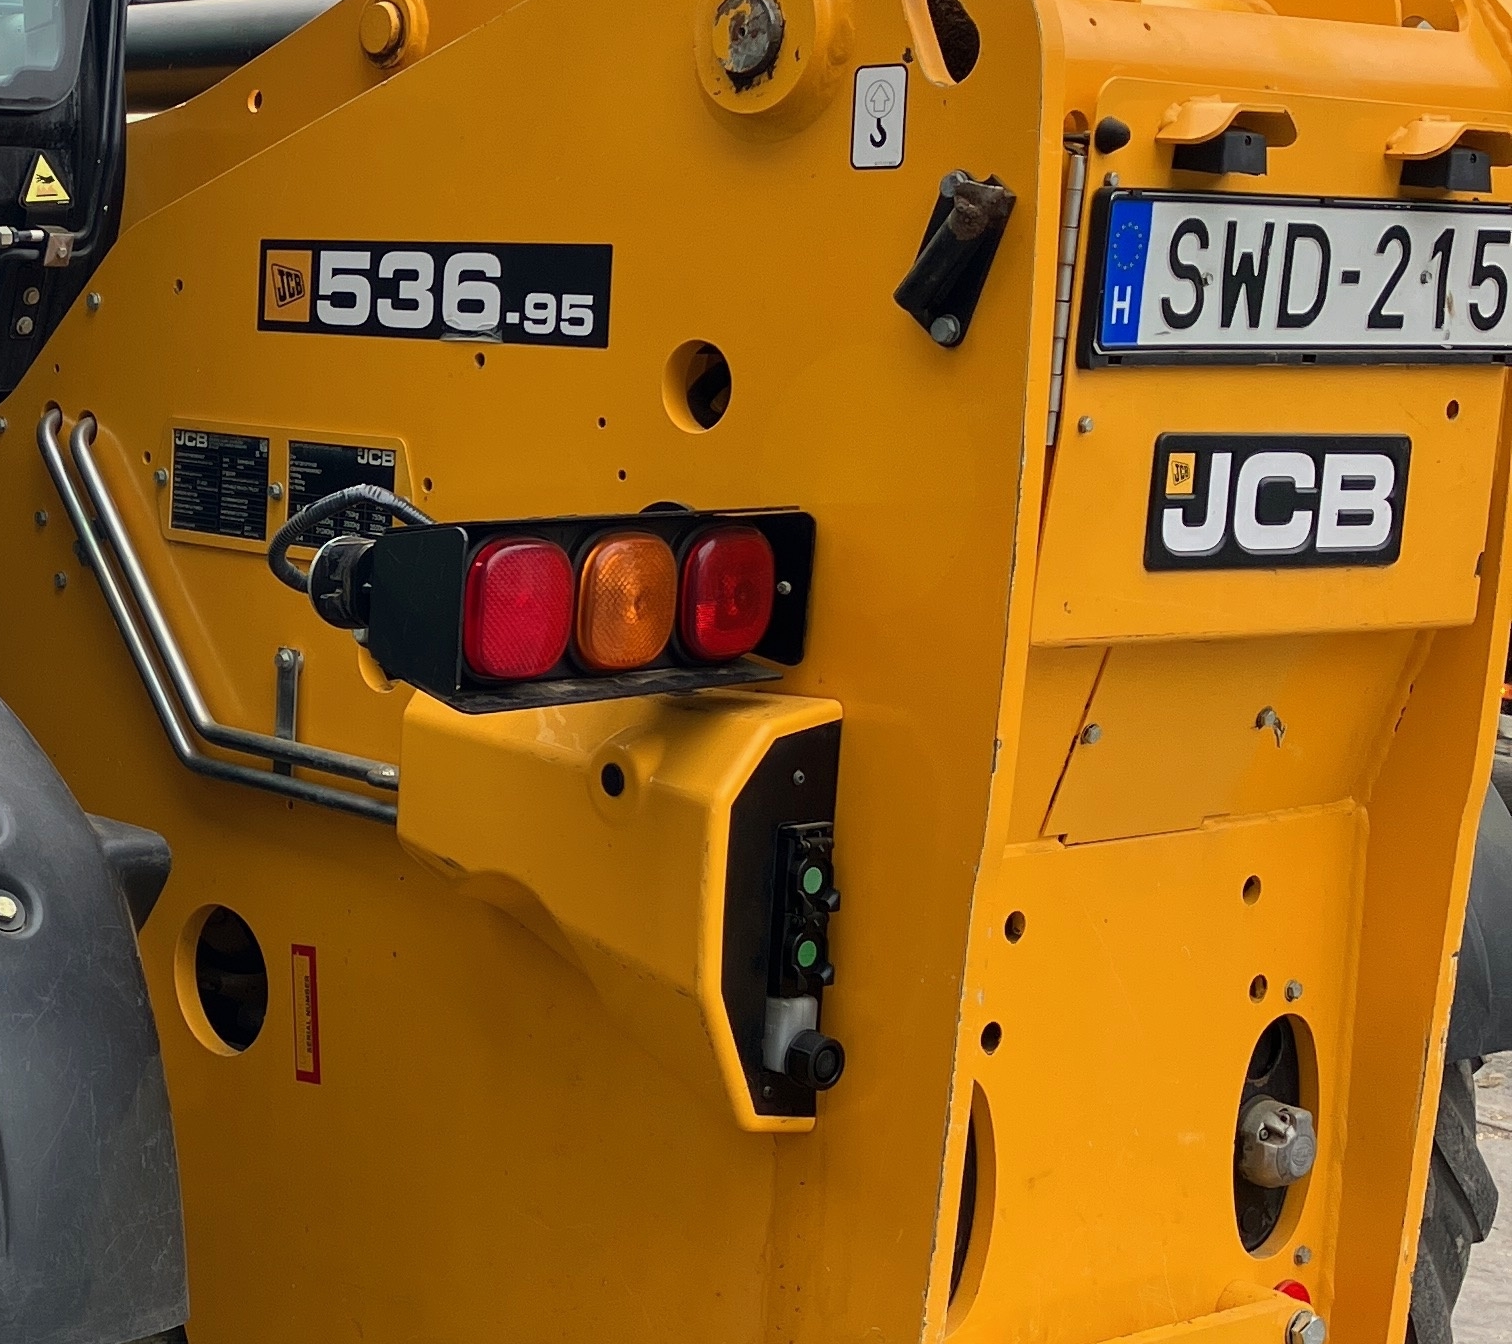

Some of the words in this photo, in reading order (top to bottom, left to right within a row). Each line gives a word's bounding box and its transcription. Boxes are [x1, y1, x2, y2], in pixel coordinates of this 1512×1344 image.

[1160, 217, 1512, 331] SWD-215
[1111, 285, 1132, 325] H
[175, 431, 208, 448] JCB
[357, 448, 395, 467] JCB
[1162, 452, 1396, 553] JCB
